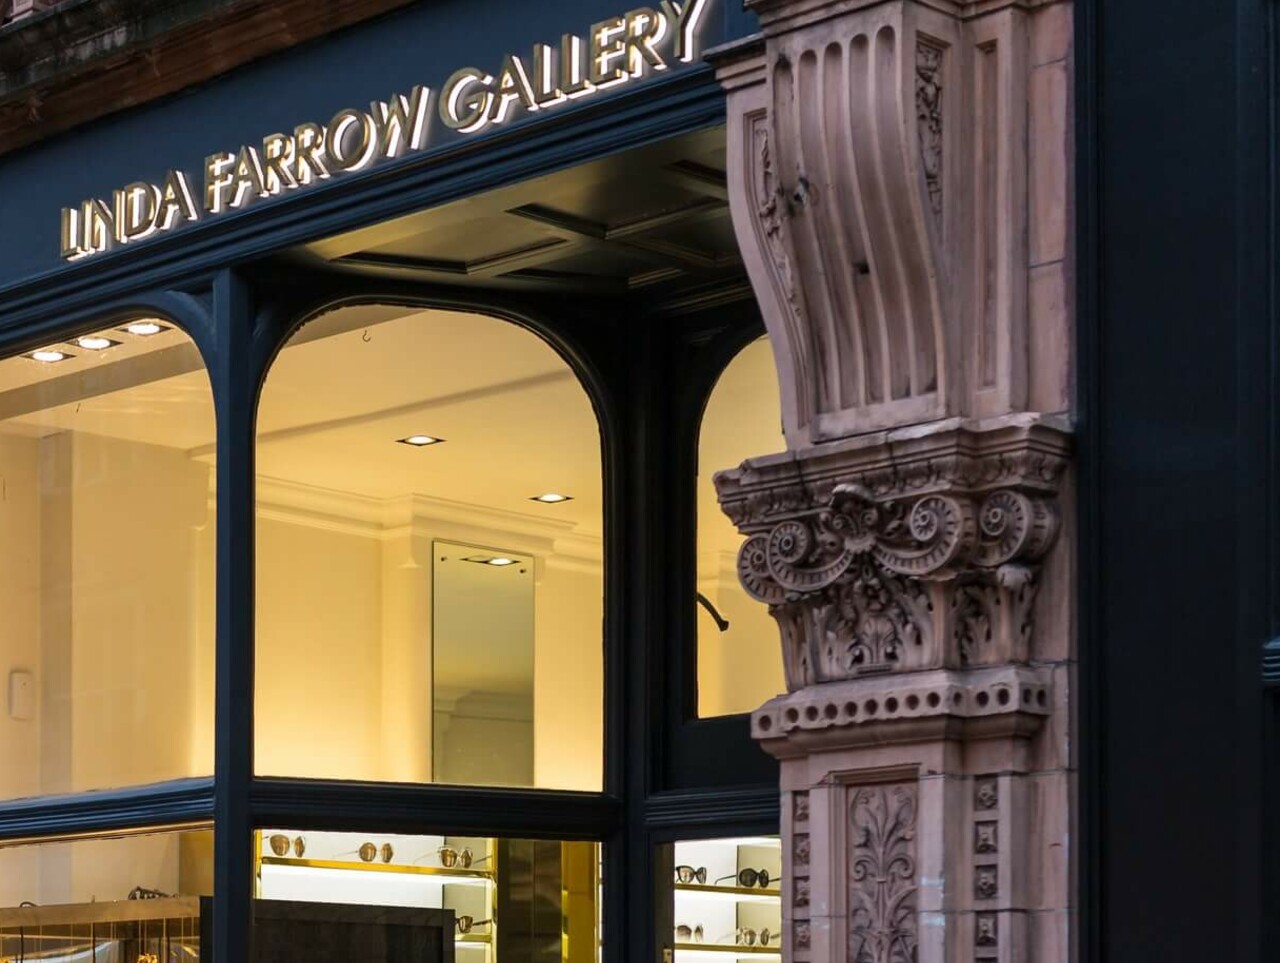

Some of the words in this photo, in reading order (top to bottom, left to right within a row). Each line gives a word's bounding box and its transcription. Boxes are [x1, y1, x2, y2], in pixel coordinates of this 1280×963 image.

[60, 168, 199, 262] LINDA
[204, 85, 431, 214] FARROW
[438, 0, 706, 133] GALLERY
